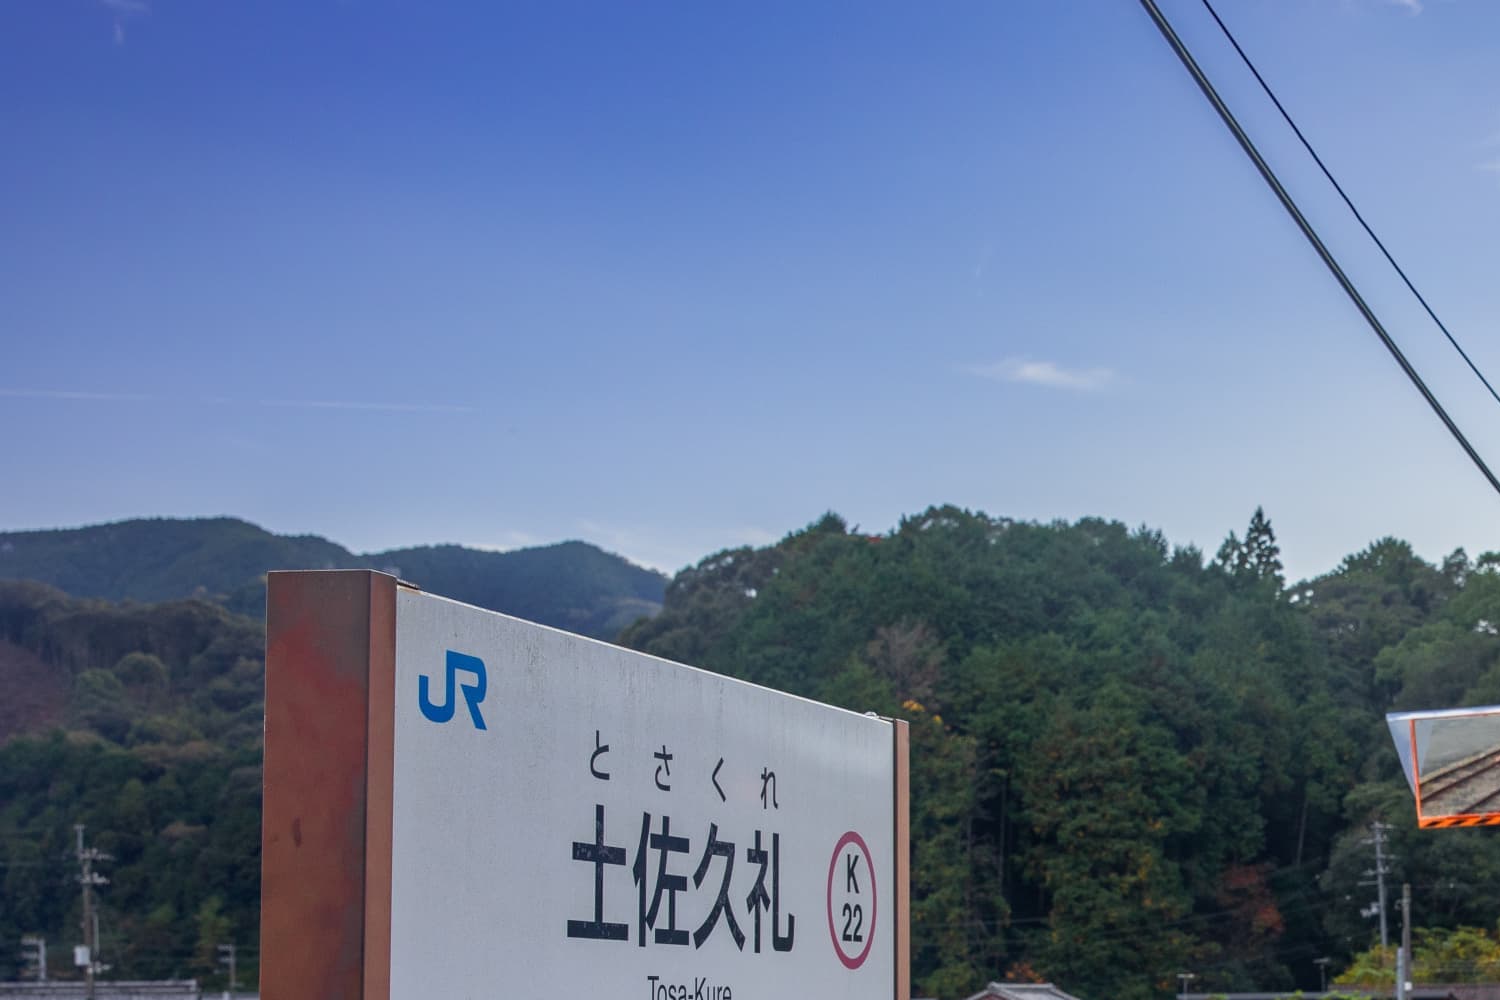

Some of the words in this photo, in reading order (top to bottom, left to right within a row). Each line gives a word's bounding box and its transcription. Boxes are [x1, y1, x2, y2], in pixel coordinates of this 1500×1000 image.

[418, 649, 488, 731] JR
[588, 729, 779, 809] とさくれ
[566, 803, 796, 954] 土佐久礼
[846, 853, 860, 894] K
[842, 903, 863, 943] 22
